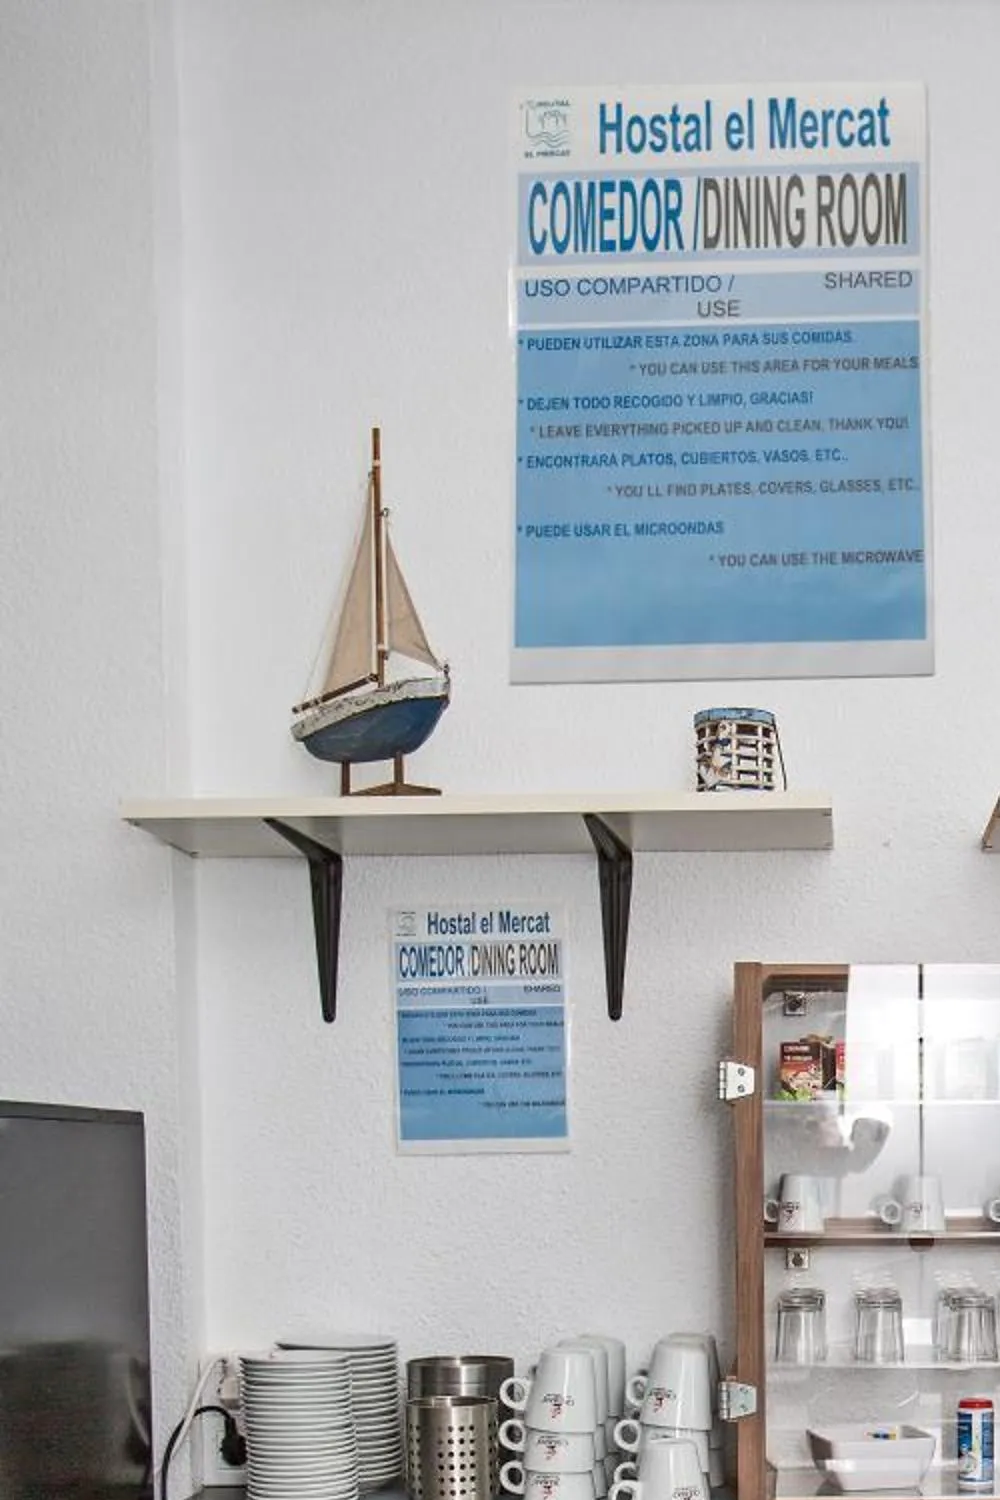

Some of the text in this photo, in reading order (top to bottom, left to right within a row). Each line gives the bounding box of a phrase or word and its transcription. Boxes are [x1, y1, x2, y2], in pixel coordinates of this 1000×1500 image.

[599, 95, 892, 155] Hostal el Mercat
[528, 177, 686, 255] COMEDOR
[816, 171, 908, 248] ROOM
[524, 278, 571, 298] USO
[576, 274, 723, 297] COMPARTIDO
[824, 270, 914, 290] SHARED
[696, 299, 741, 318] USE
[527, 337, 581, 351] PUEDEN
[583, 334, 643, 350] UTILIZAR
[645, 334, 679, 349] ESTA
[683, 333, 719, 348] ZONA
[723, 332, 759, 346] PARA
[762, 331, 790, 346] SUS
[639, 362, 668, 377] YOU
[669, 361, 698, 376] CAN
[701, 360, 728, 375] USE
[731, 359, 761, 374] THIS
[763, 358, 800, 373] AREA
[803, 357, 830, 372] FOR
[833, 357, 870, 372] YOUR
[526, 389, 814, 412] DEJEN TODO RECOGIDO Y LIMPIO, GRACIAS!
[538, 423, 582, 440] LEAVE
[585, 421, 669, 438] EVERYTHING
[672, 420, 721, 435] PICKED
[725, 419, 743, 434] UP
[745, 418, 774, 433] AND
[829, 415, 873, 432] THANK
[620, 451, 678, 469] PLATOS,
[615, 484, 644, 498] YOU
[667, 482, 697, 497] FIND
[526, 518, 725, 539] PUEDE USAR EL MICROONDAS
[718, 547, 924, 569] YOU CAN USE THE MICROWAVE
[427, 911, 476, 936] Hostal
[479, 911, 493, 934] el
[499, 910, 551, 934] Mercat
[400, 945, 465, 978] COMEDOR
[519, 942, 559, 976] ROOM
